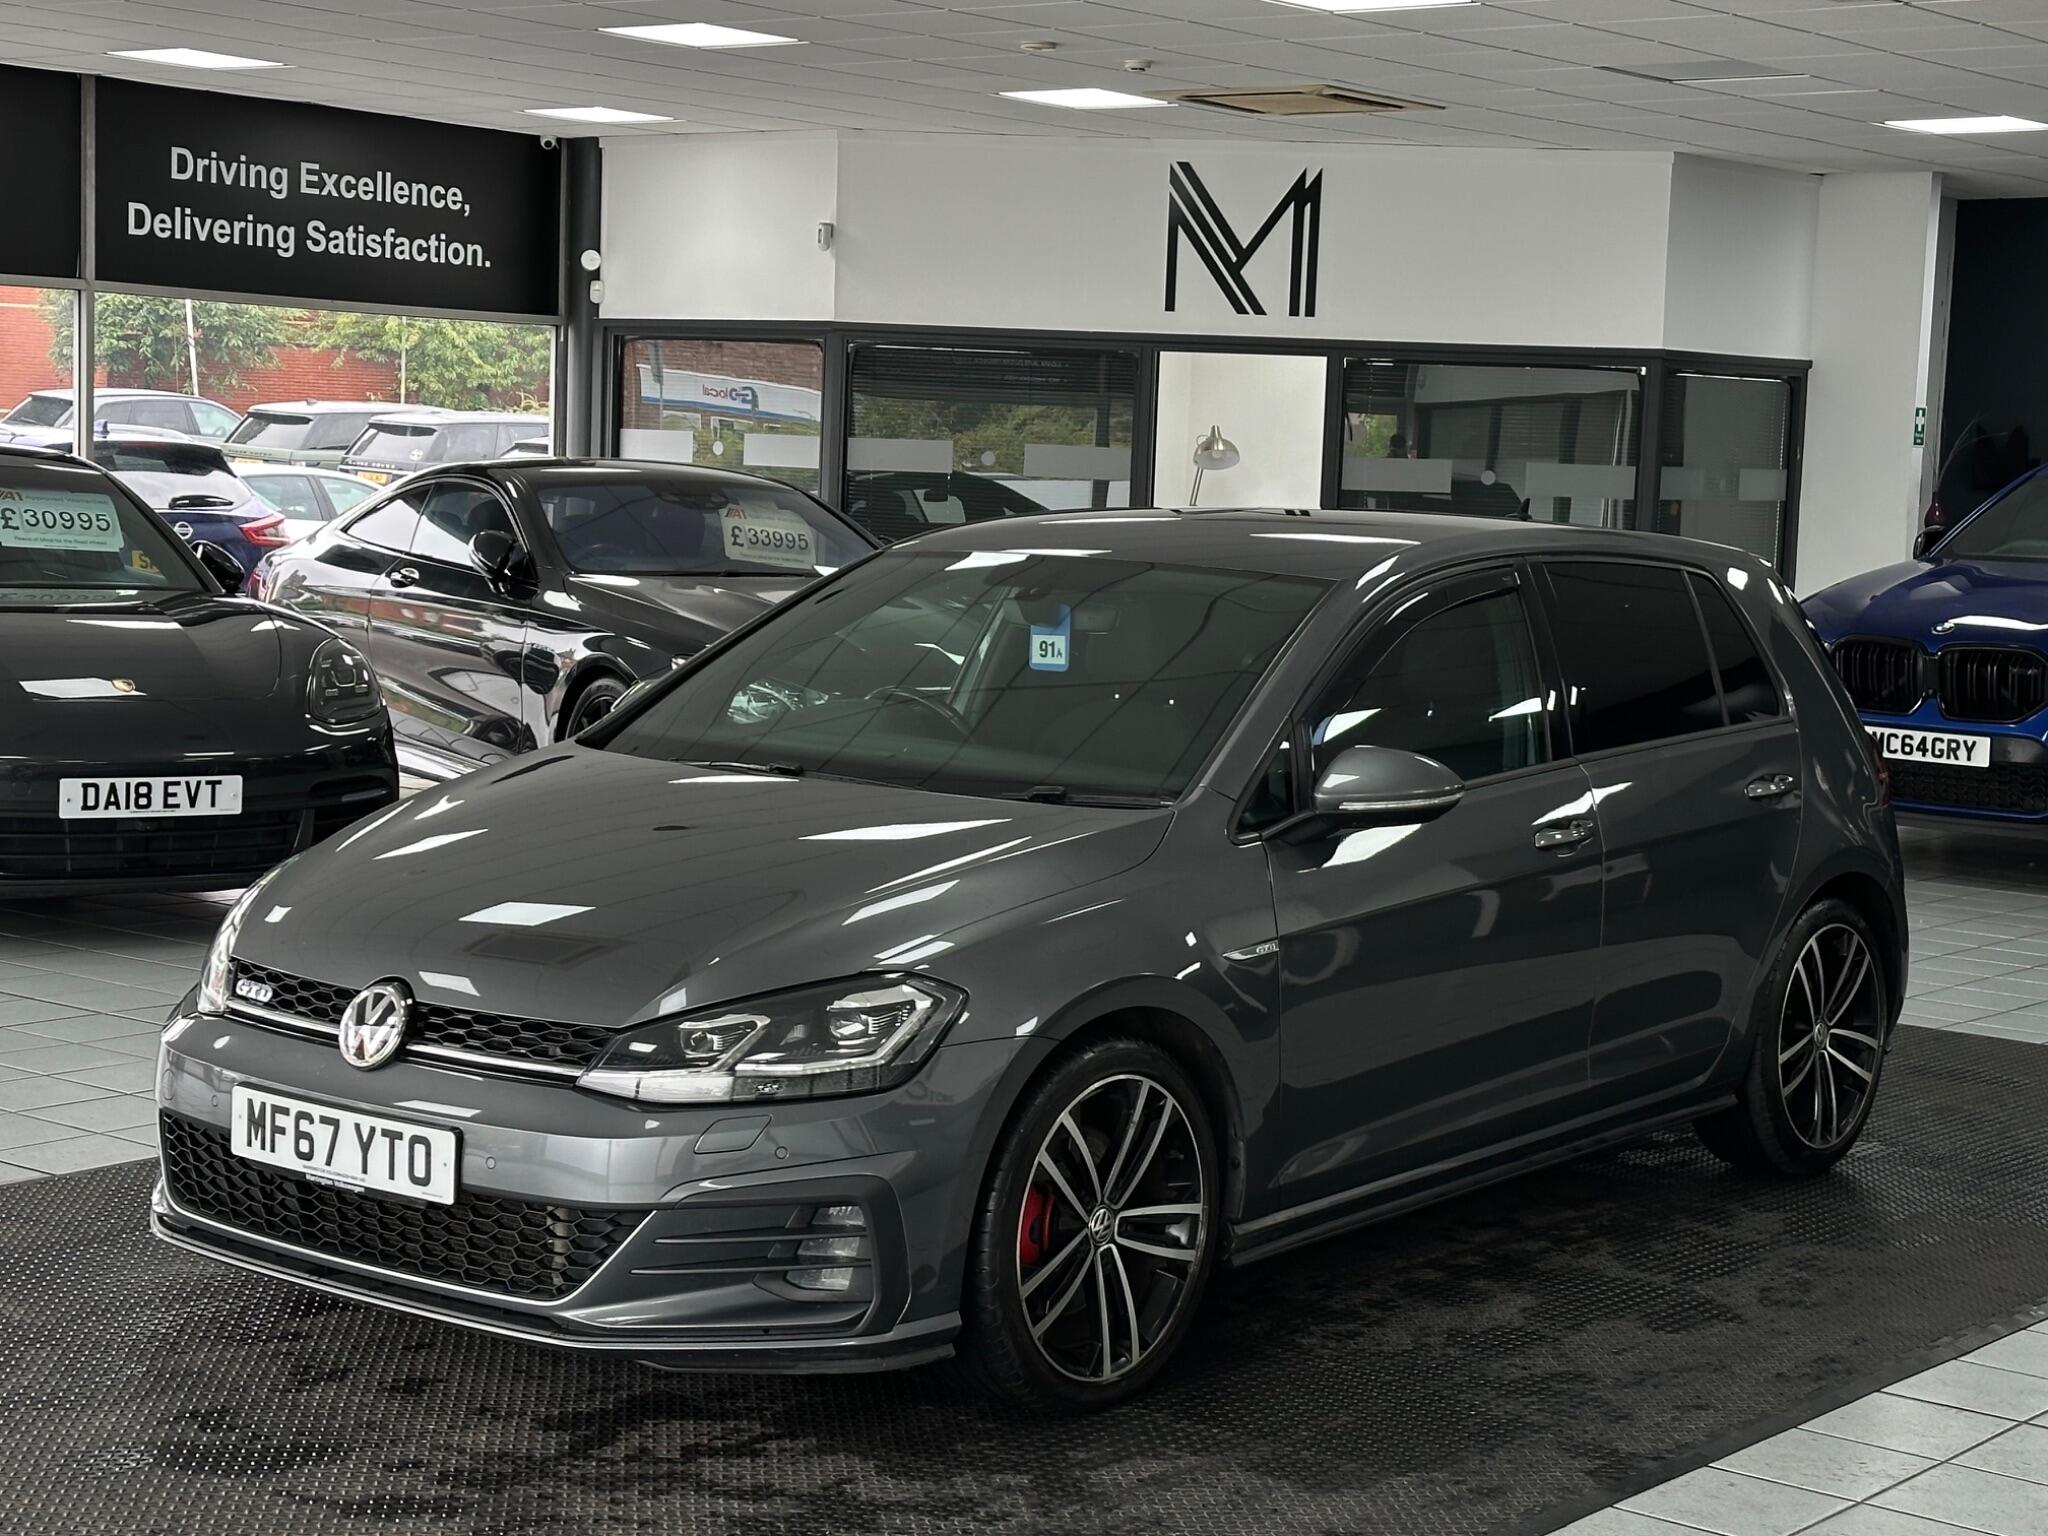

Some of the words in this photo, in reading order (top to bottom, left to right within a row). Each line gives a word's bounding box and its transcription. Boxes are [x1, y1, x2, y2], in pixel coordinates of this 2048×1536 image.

[170, 146, 289, 200] Driving
[299, 161, 472, 217] Excellence,
[127, 201, 296, 258] Delivering
[305, 220, 492, 268] Satisfaction.
[0, 507, 111, 532] £30995
[730, 525, 809, 551] £33995
[80, 781, 153, 811] DA18
[162, 780, 222, 809] EVT
[246, 1097, 340, 1167] MF67
[353, 1122, 432, 1188] YTO
